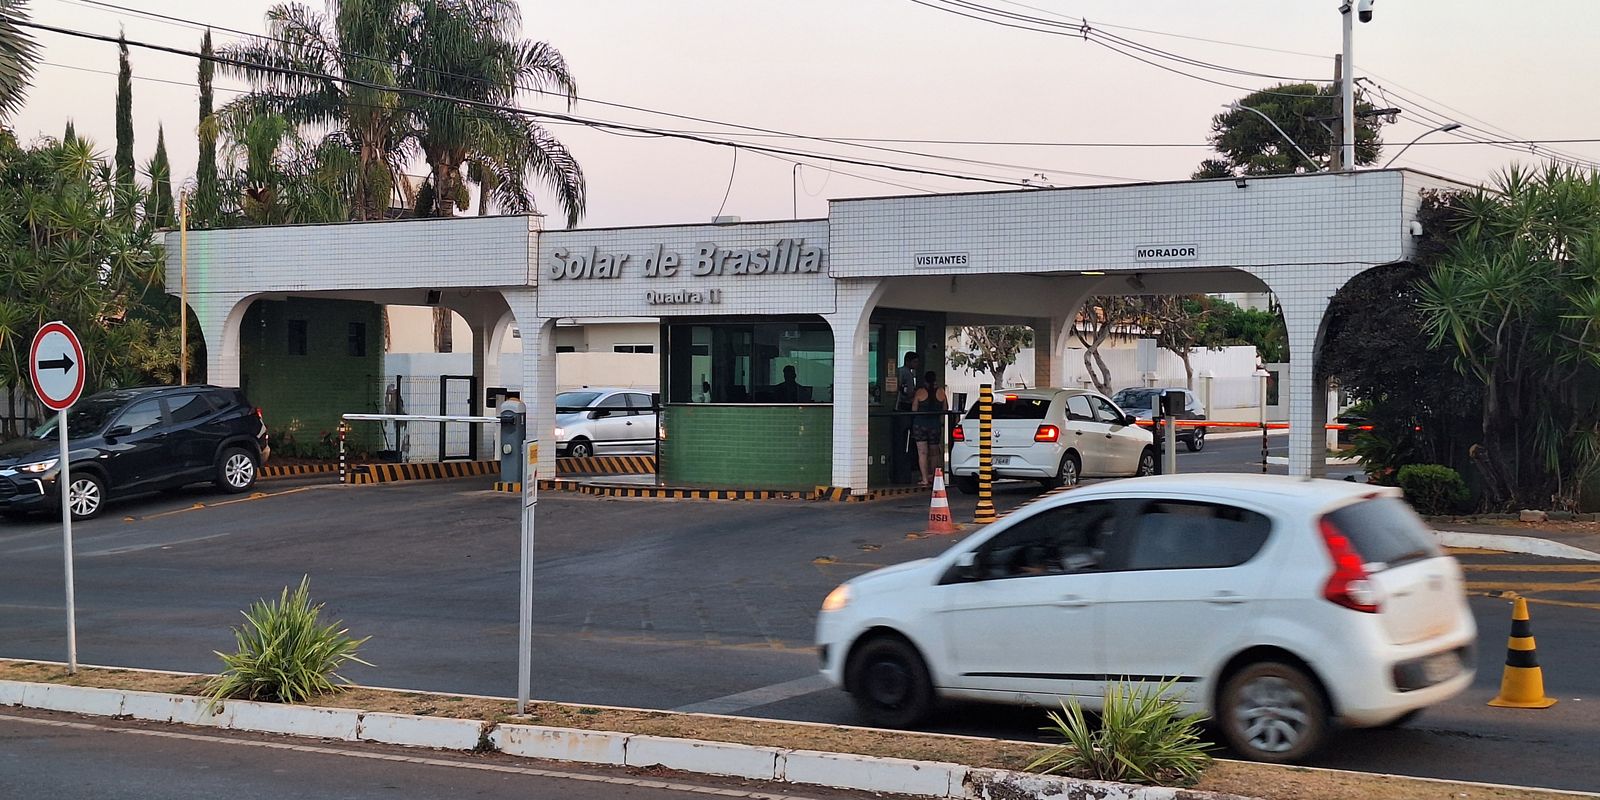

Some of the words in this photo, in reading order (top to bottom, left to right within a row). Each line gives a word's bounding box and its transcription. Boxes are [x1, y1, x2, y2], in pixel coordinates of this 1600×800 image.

[550, 246, 629, 280] Solar
[640, 243, 680, 278] de
[691, 238, 822, 276] Brasília
[1137, 247, 1195, 258] MORADOR
[916, 254, 967, 266] VISITANTES
[645, 289, 702, 304] Quadra
